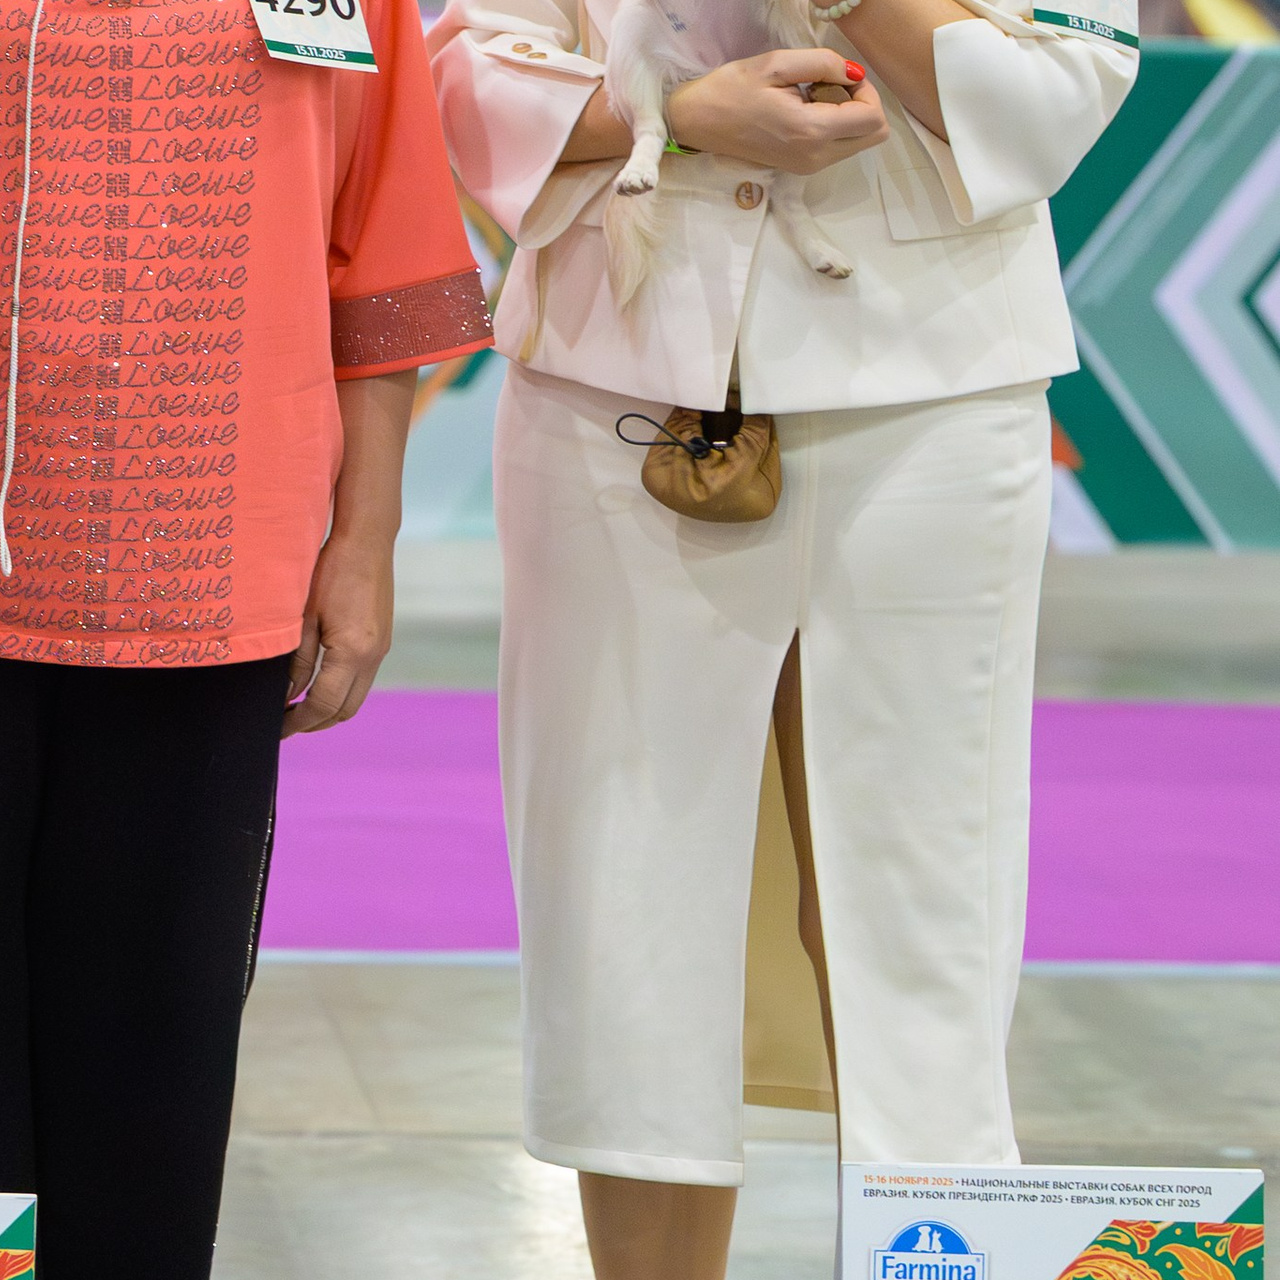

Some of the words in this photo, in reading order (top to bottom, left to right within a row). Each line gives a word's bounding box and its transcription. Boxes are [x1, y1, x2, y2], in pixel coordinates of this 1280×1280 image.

[1067, 15, 1115, 39] 15.11.2025
[134, 39, 263, 68] Loewe
[295, 45, 346, 60] 15.11.2025
[134, 70, 264, 100] Loewe
[131, 104, 261, 131] Loewe
[131, 136, 259, 163] Loewe
[130, 170, 255, 196] Loewe
[129, 202, 252, 228] Loewe
[129, 234, 250, 260] Loewe
[126, 265, 248, 292] Loewe
[124, 297, 246, 323] Loewe
[124, 329, 245, 356] Loewe
[121, 362, 242, 388] Loewe
[120, 391, 240, 418] Loewe
[116, 423, 239, 449] Loewe
[112, 453, 237, 480] Loewe
[110, 484, 236, 511] Loewe
[111, 515, 235, 542] Loewe
[110, 545, 235, 572] Loewe
[110, 575, 233, 603] Loewe
[108, 606, 234, 632] Loewe
[108, 639, 232, 664] Loewe
[863, 1188, 910, 1199] ЕВРАЗИЯ.
[912, 1190, 946, 1200] КУБОК
[948, 1191, 1015, 1202] ПРЕЗИДЕНТА
[1017, 1194, 1038, 1203] РКФ
[1040, 1194, 1063, 1204] 2025
[1070, 1195, 1117, 1206] ЕВРАЗИЯ.
[1119, 1197, 1153, 1207] КУБОК
[1155, 1198, 1176, 1207] СНГ
[1177, 1199, 1201, 1208] 2025
[864, 1175, 887, 1184] 15-16
[889, 1176, 929, 1186] НОЯБРЯ
[931, 1177, 954, 1186] 2025
[961, 1178, 1050, 1189] НАЦИОНАЛЬНЫЕ
[1052, 1181, 1108, 1191] ВЫСТАВКИ
[1110, 1182, 1146, 1192] СОБАК
[1148, 1184, 1173, 1193] ВСЕХ
[1175, 1185, 1213, 1196] ПОРОД
